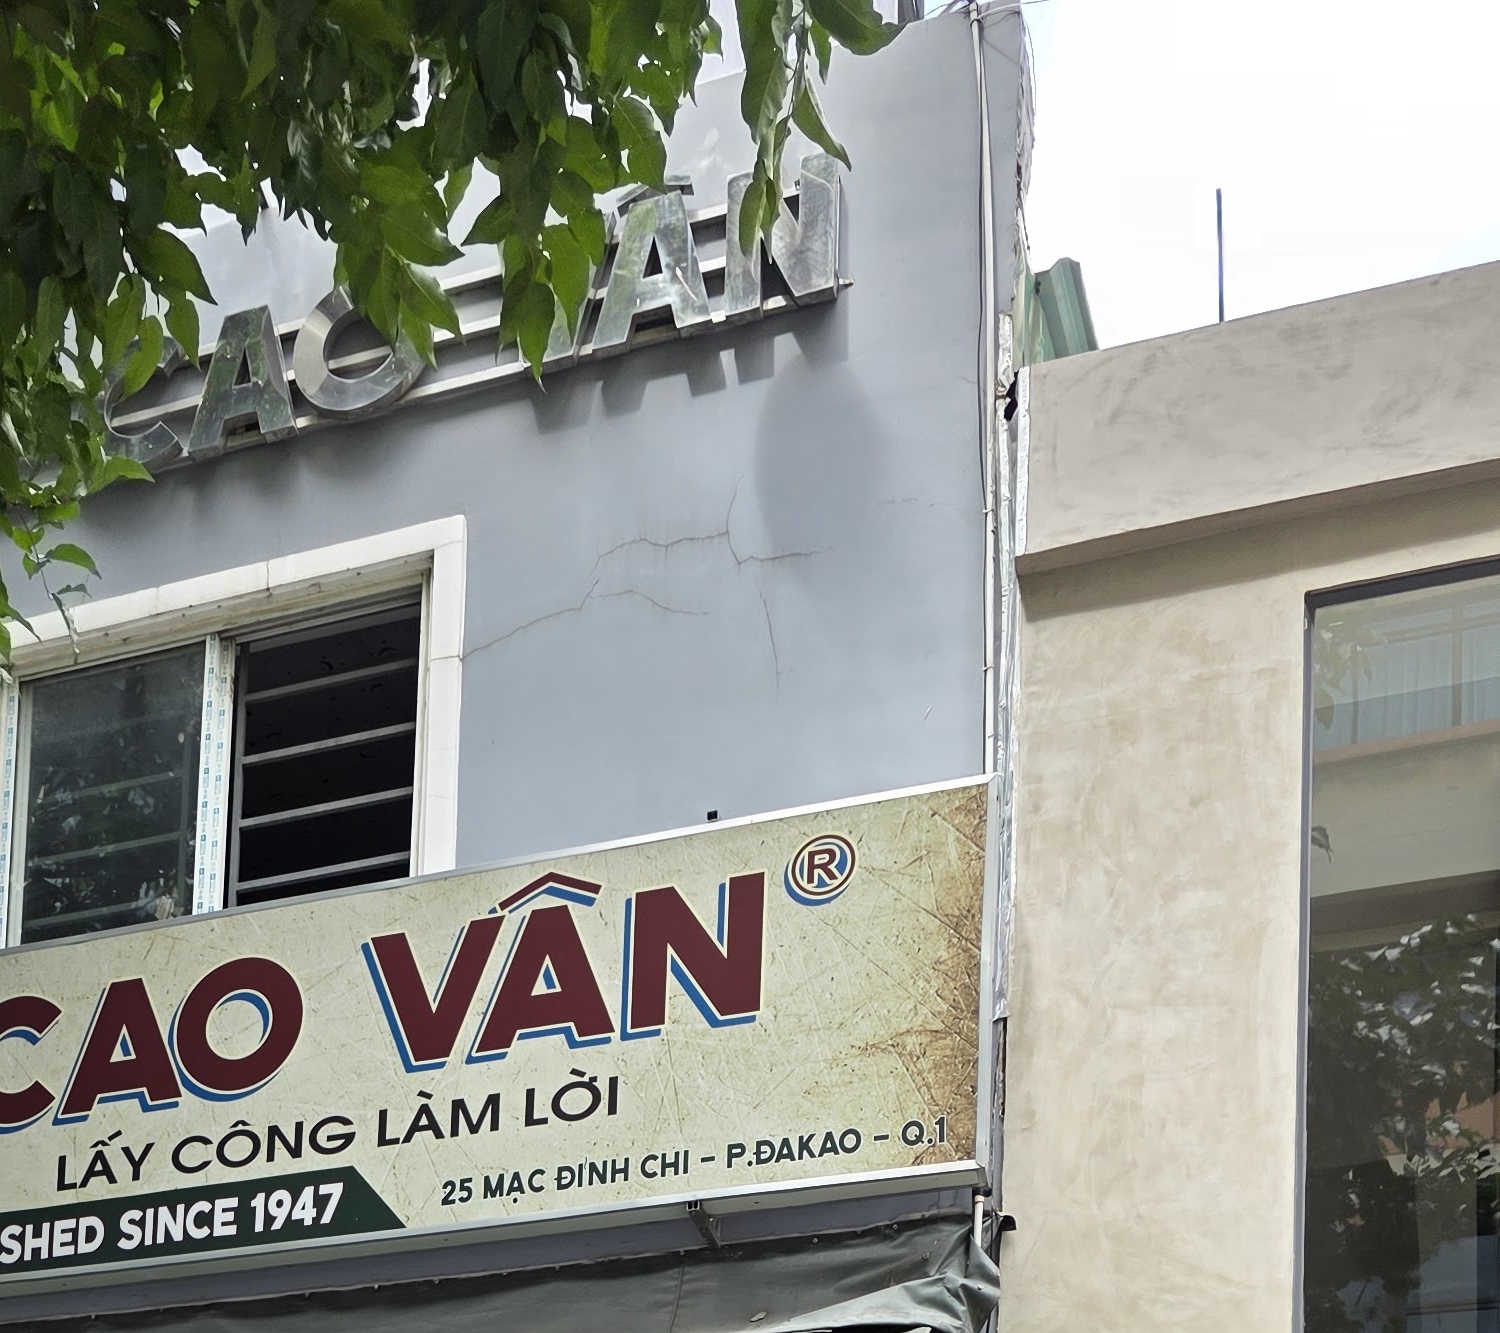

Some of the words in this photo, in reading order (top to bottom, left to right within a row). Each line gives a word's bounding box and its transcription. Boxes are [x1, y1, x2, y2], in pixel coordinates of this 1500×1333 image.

[361, 871, 765, 1074] VÂN
[56, 1129, 155, 1192] LẤY
[170, 1115, 357, 1175] CÔNG
[376, 1090, 501, 1149] LÀM
[524, 1067, 619, 1128] LỜI
[441, 1176, 475, 1207] 25
[482, 1166, 546, 1204] MẠC
[639, 1148, 690, 1179] CHI
[726, 1127, 863, 1170] P.ĐAKAO
[900, 1115, 949, 1149] Q.1
[117, 1197, 240, 1250] SINCE
[251, 1182, 344, 1231] 1947
